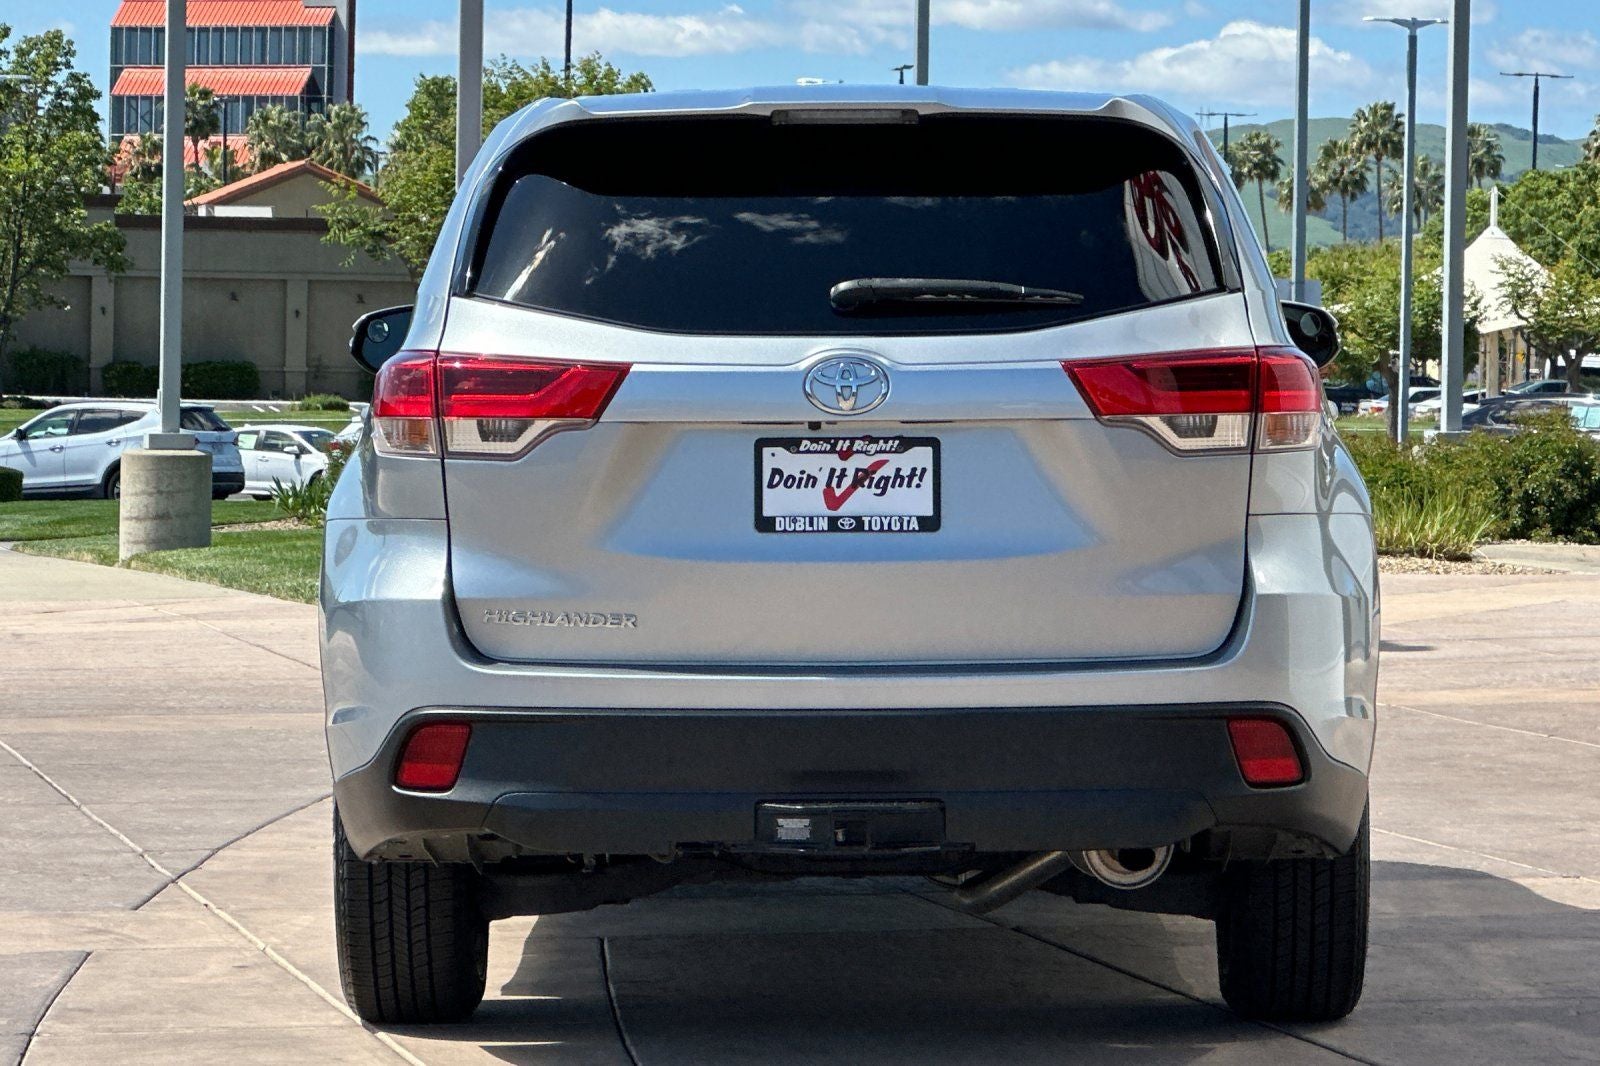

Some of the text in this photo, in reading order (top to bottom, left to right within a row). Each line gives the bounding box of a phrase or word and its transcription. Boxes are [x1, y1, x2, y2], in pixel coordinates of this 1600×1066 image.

[799, 439, 900, 456] Doin' It Right!
[766, 466, 927, 496] Doin' It Right!
[775, 516, 919, 531] DUBLIN TOYOTA
[483, 609, 638, 629] HIGHLANDER
